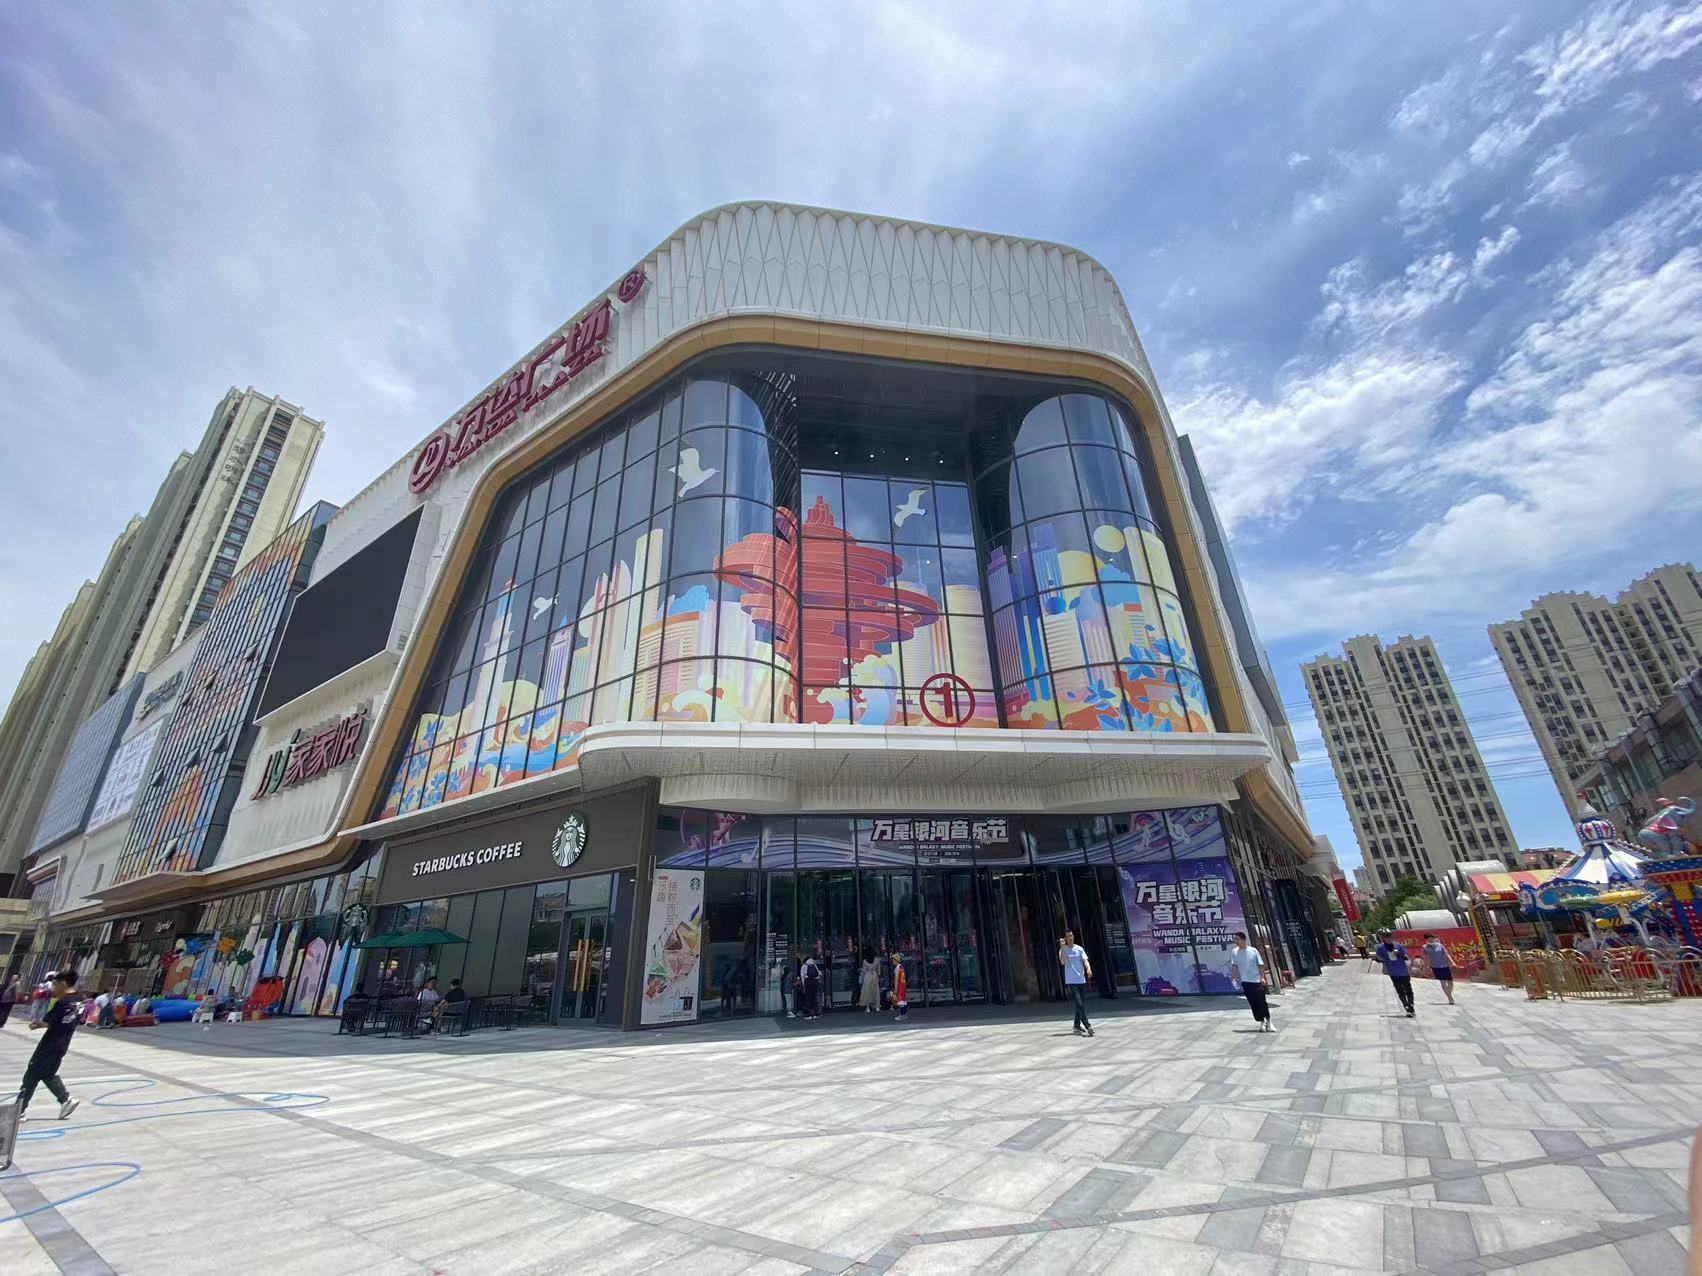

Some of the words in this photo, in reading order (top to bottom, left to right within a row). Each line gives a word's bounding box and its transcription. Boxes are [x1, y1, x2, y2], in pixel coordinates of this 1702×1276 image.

[448, 297, 612, 454] 万达广场
[445, 407, 519, 469] WANDA
[521, 342, 604, 413] PLAZA
[281, 707, 368, 788] 家家悦
[871, 818, 1008, 843] 万星银河音乐节
[411, 851, 475, 877] STARBUCKS
[476, 841, 523, 865] COFFEE
[1136, 878, 1225, 903] 万星银河
[1152, 900, 1222, 925] 音乐节
[1153, 928, 1185, 938] WANDA
[1164, 936, 1191, 944] MUSIC
